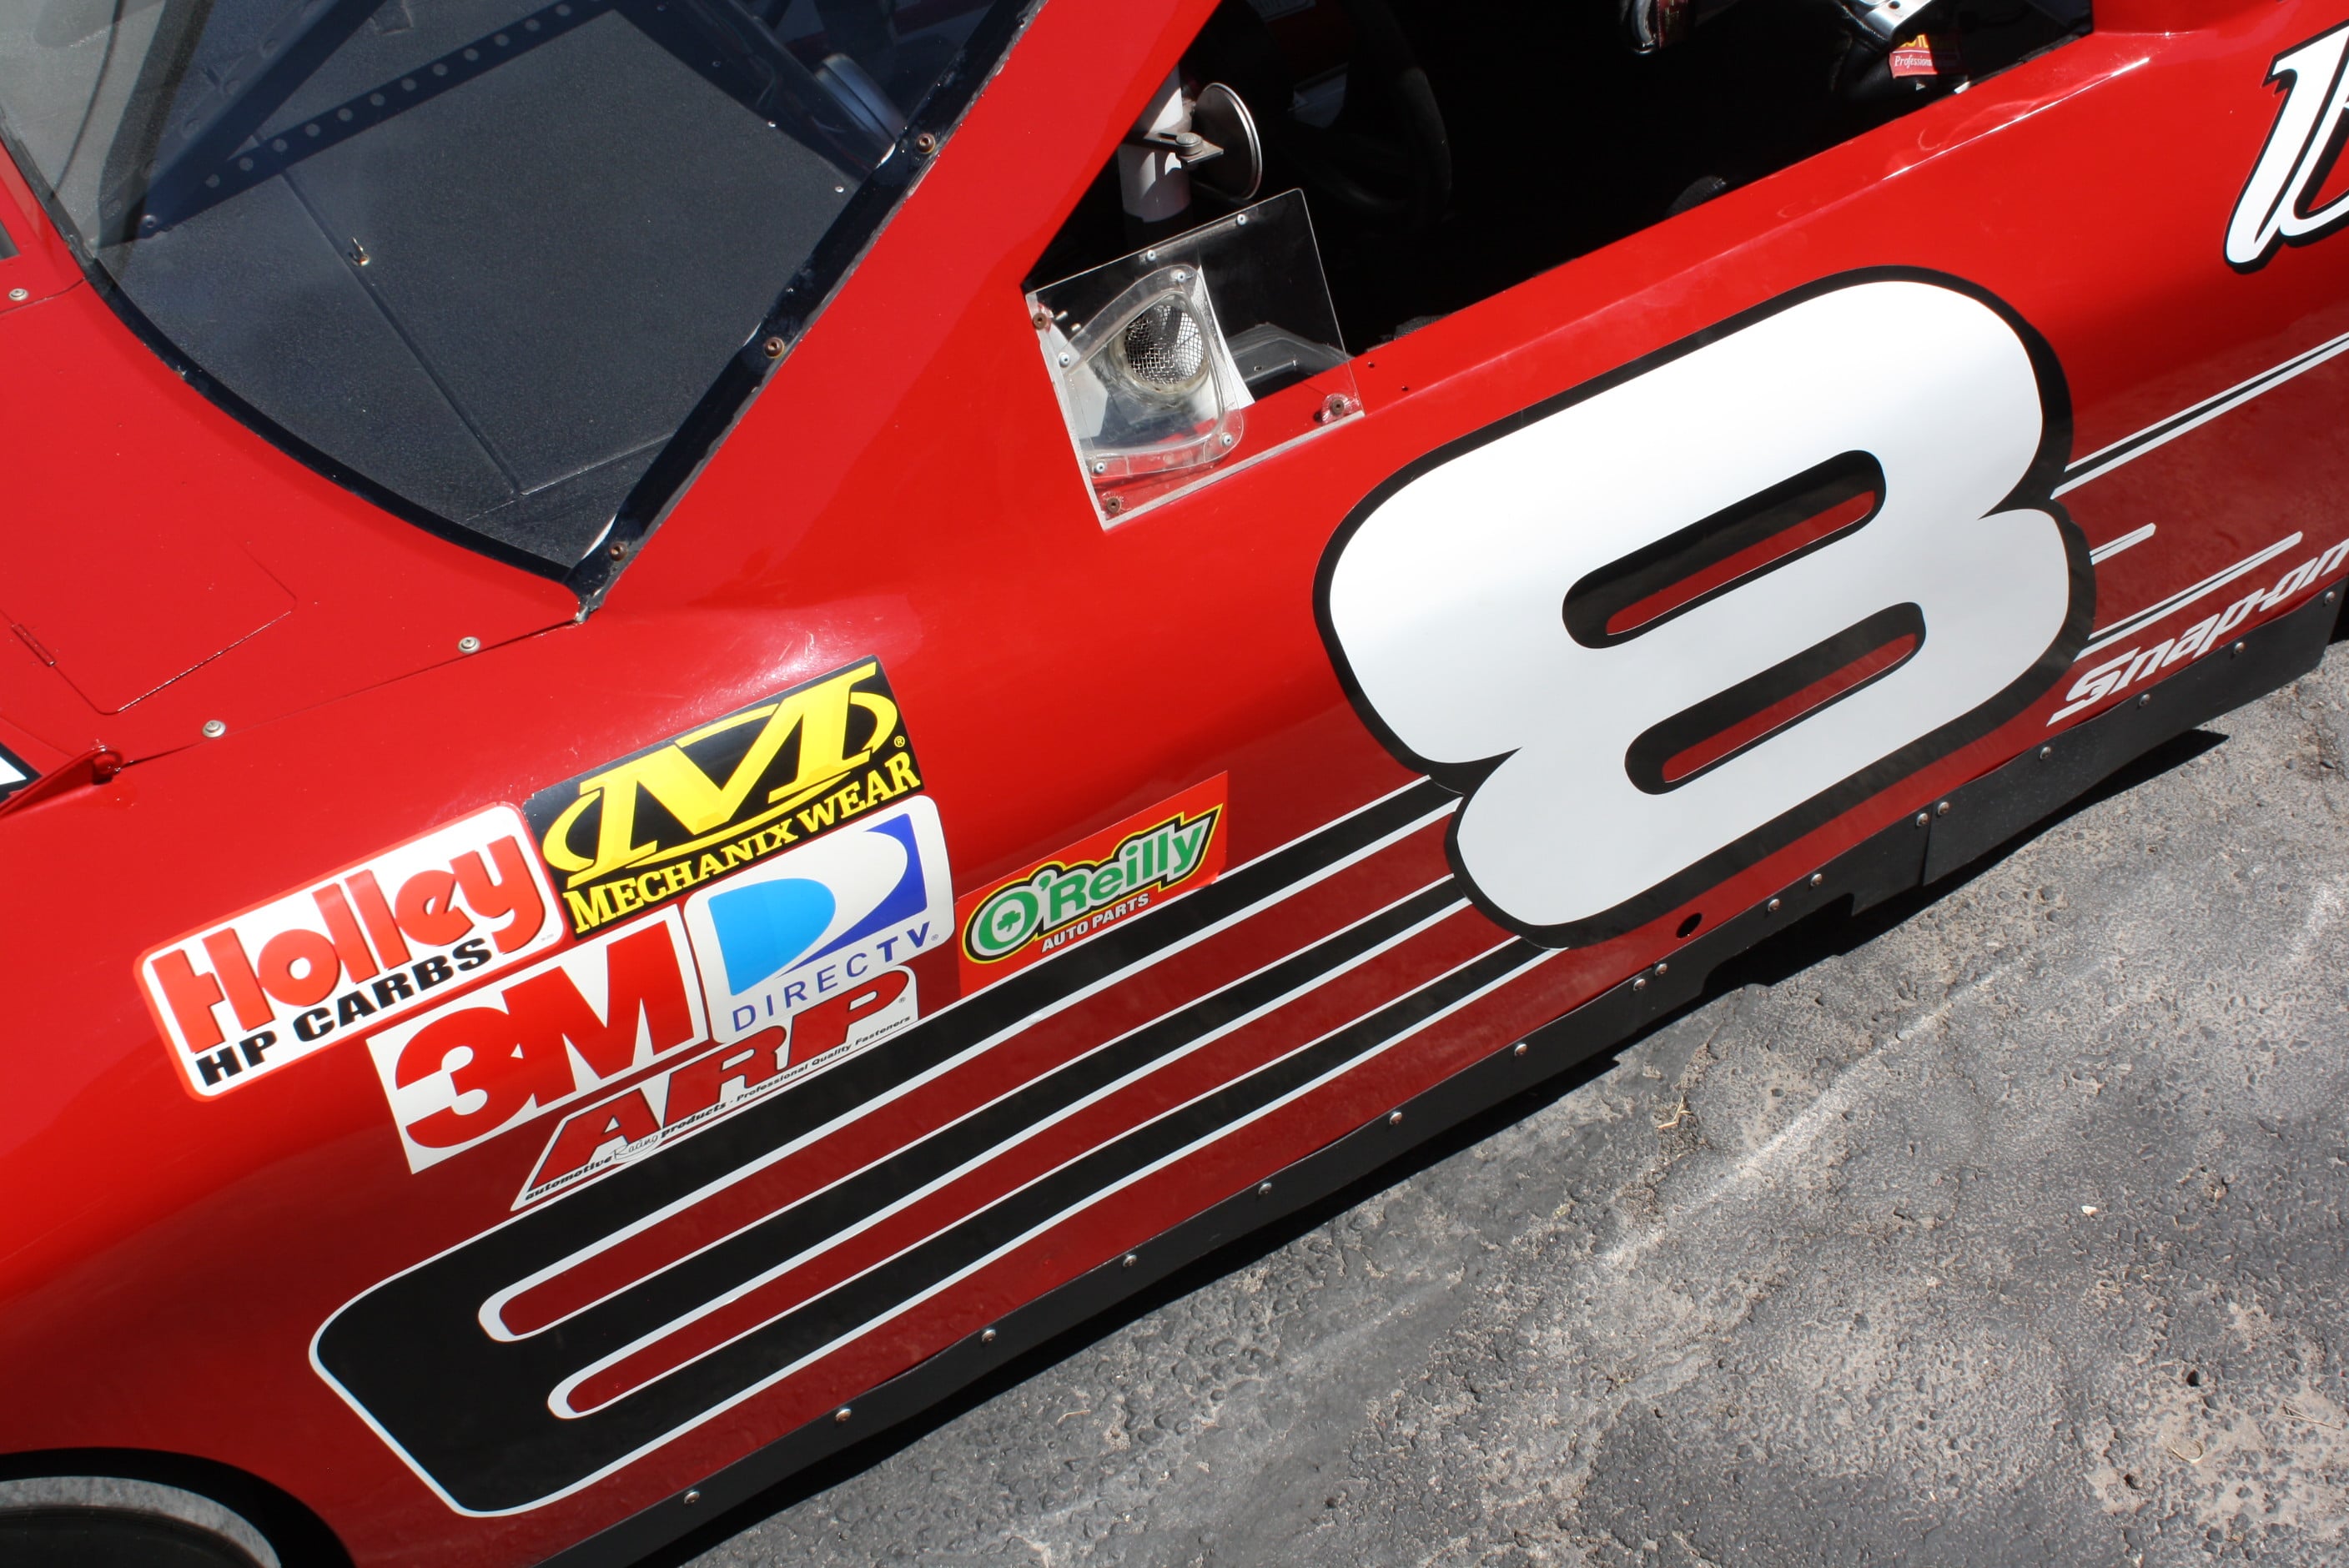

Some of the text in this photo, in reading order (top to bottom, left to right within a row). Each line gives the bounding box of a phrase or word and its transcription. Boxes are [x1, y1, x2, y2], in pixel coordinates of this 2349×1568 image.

[1313, 265, 2095, 947] 8
[562, 751, 920, 934] MECHANIX WEAR
[978, 826, 1203, 950] O'Reilly
[1041, 892, 1149, 953] AUTO PARTS
[151, 835, 546, 1053] Holley
[195, 937, 492, 1087] HP CARBS
[395, 920, 694, 1148] 3M
[732, 922, 931, 1033] DIRECTV
[525, 1155, 613, 1201] automotive
[661, 1102, 727, 1139] products
[737, 1063, 808, 1102] Professional
[812, 1043, 853, 1066] Quality
[854, 1015, 911, 1046] Fasteners
[527, 970, 909, 1193] ARP
